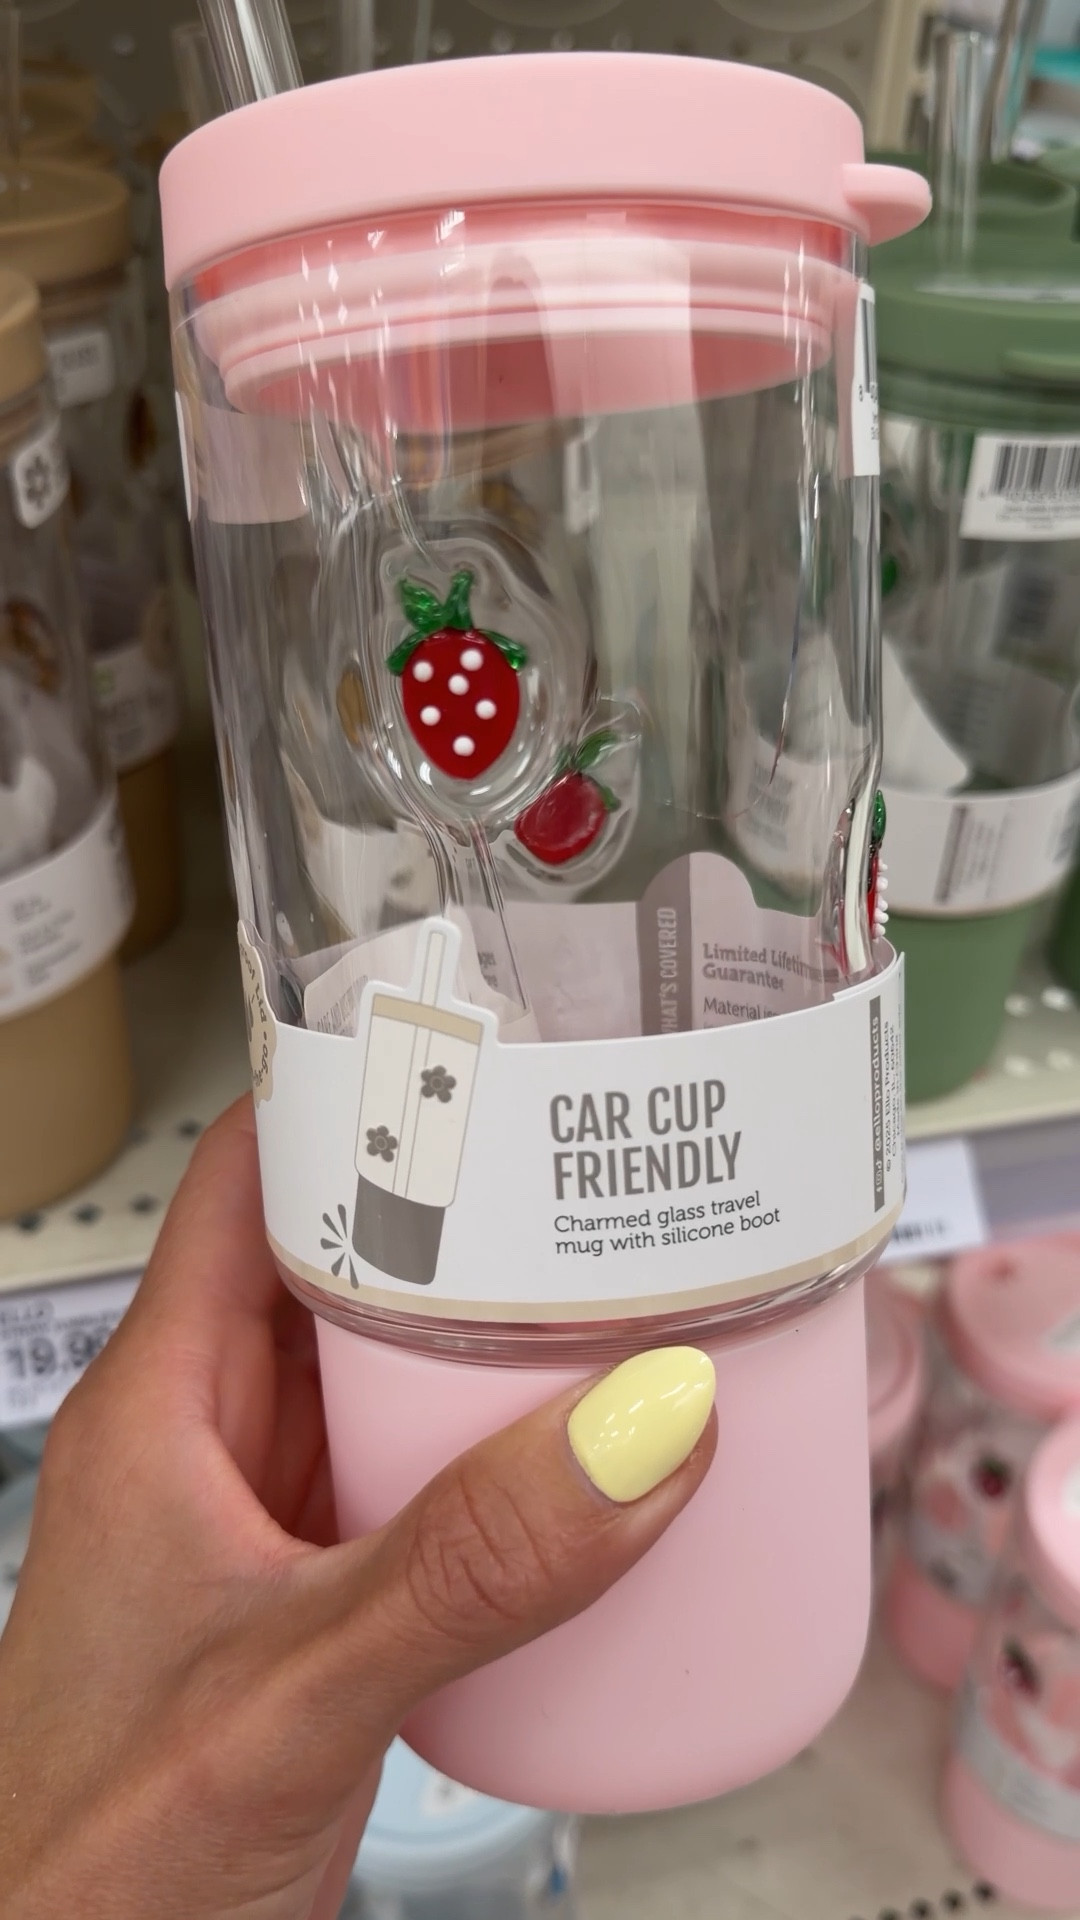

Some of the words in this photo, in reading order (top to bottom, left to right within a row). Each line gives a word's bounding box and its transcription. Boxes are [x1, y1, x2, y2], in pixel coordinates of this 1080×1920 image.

[657, 907, 677, 978] COVERED
[702, 943, 767, 964] Limited
[703, 996, 761, 1020] Material
[549, 1091, 632, 1144] CAR
[646, 1079, 727, 1136] CUP
[872, 1016, 883, 1151] @elloproducts
[553, 1131, 742, 1200] FRIENDLY
[554, 1209, 652, 1233] Charmed
[657, 1204, 706, 1229] glass
[711, 1190, 761, 1216] travel
[555, 1239, 604, 1257] mug
[609, 1231, 656, 1251] with
[661, 1220, 735, 1246] silicone
[739, 1208, 781, 1231] boot
